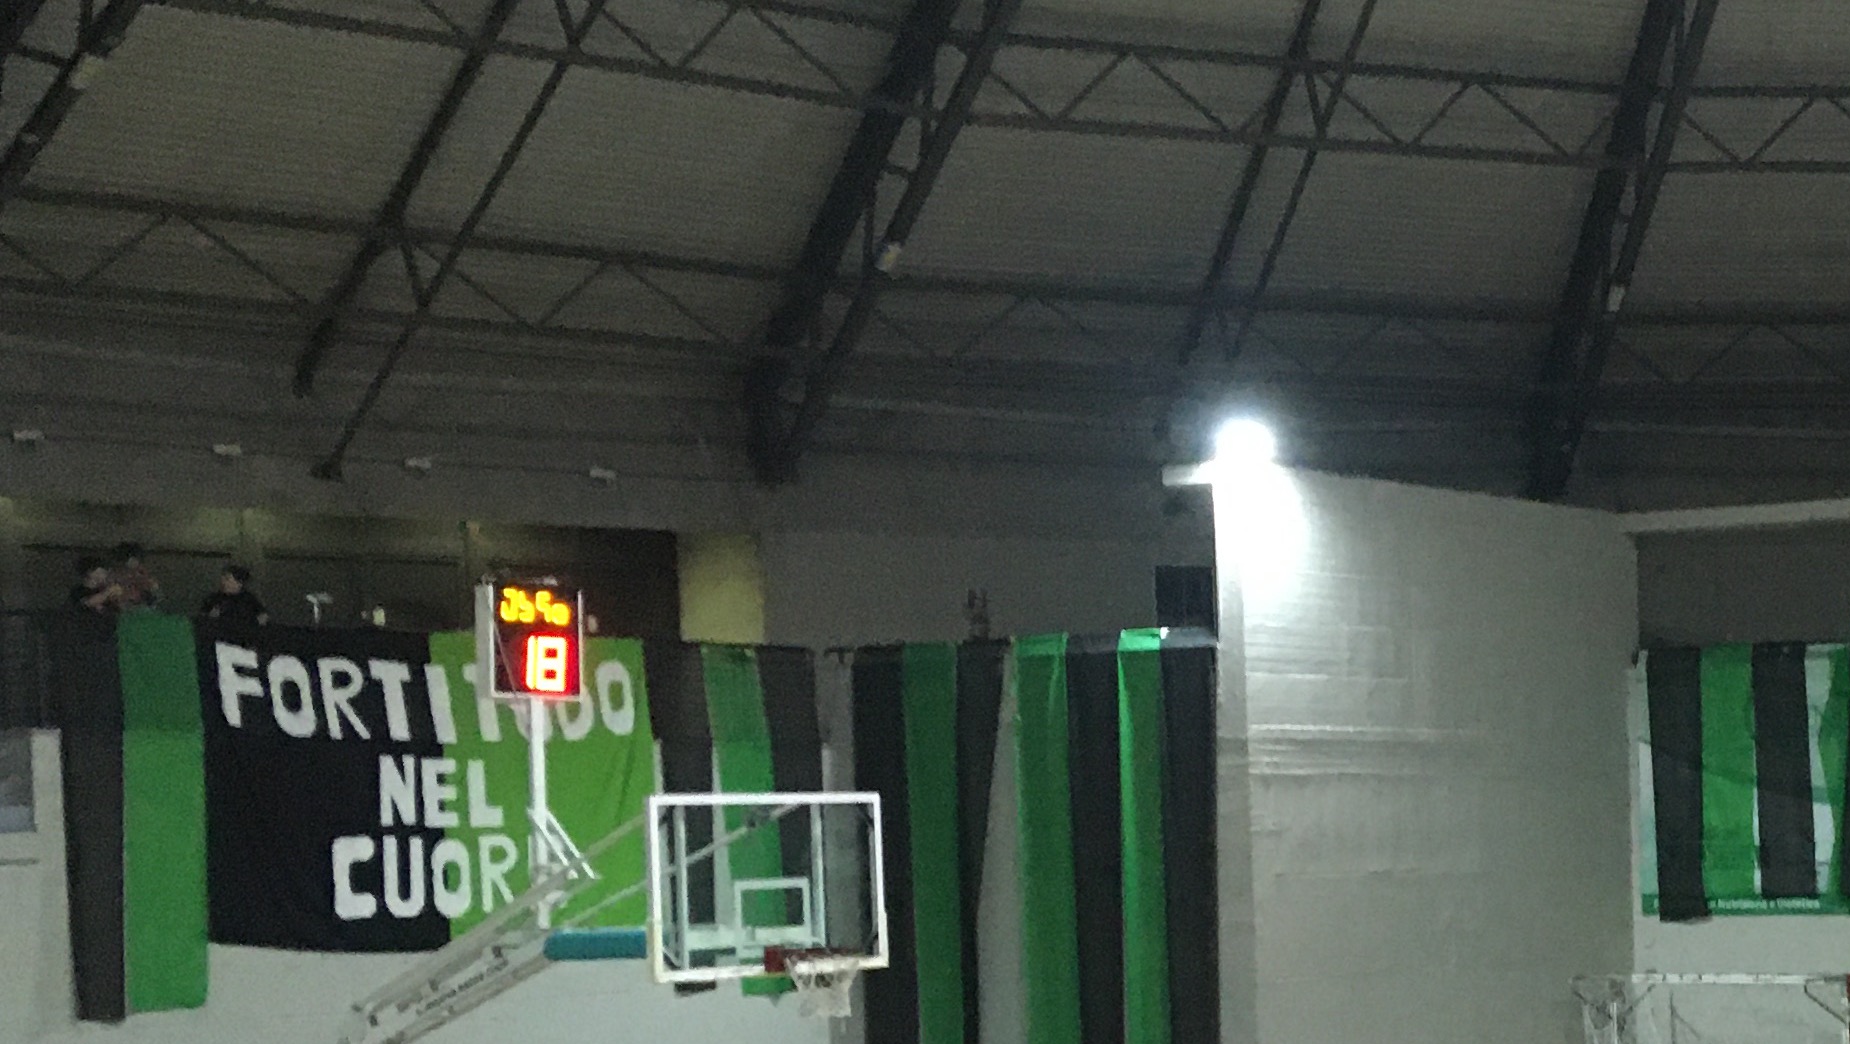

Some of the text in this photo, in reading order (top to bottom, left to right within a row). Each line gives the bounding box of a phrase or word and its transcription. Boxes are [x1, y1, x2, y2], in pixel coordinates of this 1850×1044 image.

[525, 634, 568, 693] 18
[379, 753, 505, 829] NEL
[331, 834, 556, 921] CUOR
